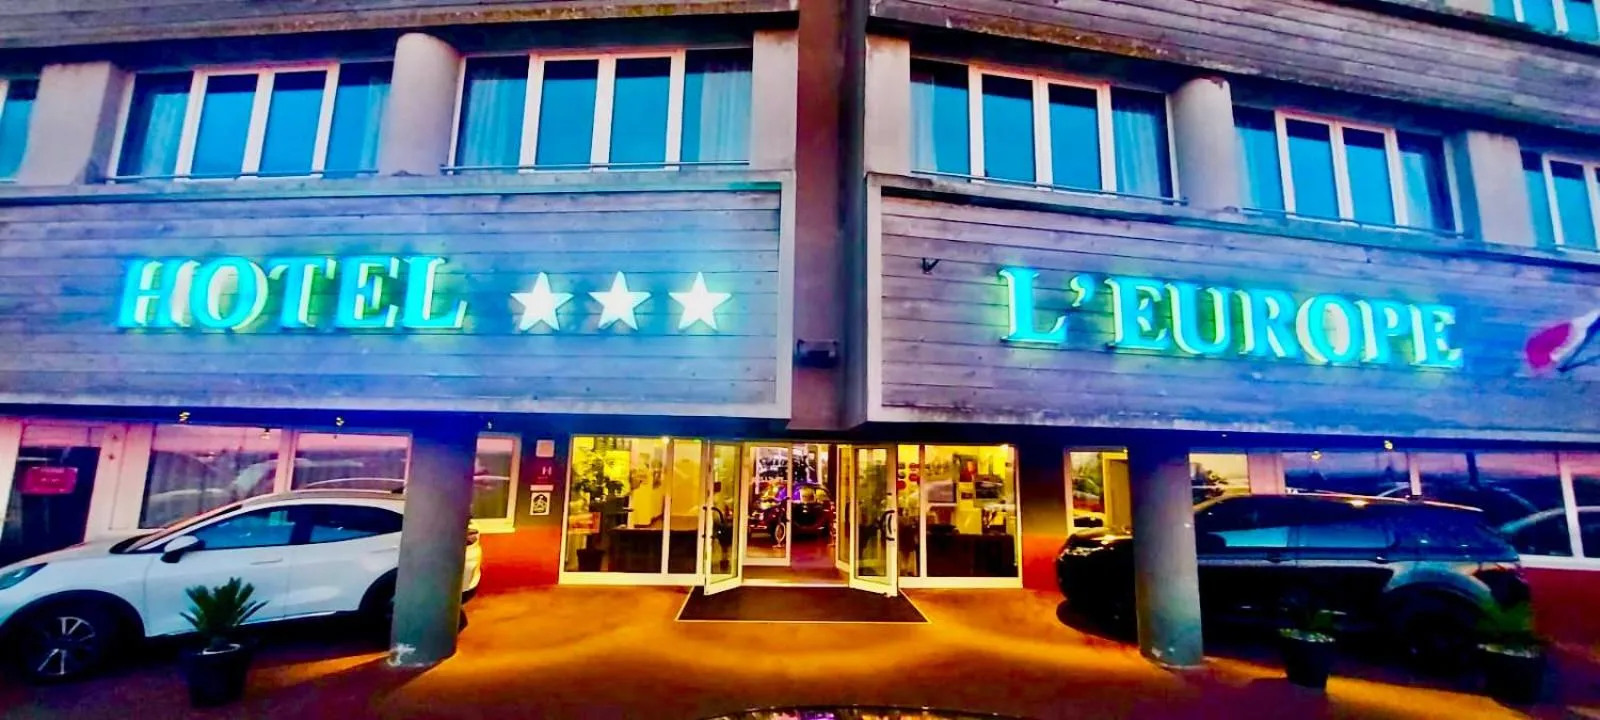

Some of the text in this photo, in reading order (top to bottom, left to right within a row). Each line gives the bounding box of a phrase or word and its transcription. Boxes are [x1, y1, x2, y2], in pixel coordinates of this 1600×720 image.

[117, 255, 467, 329] HOTEL
[999, 266, 1465, 369] L'EUROPE
[541, 466, 552, 476] H
